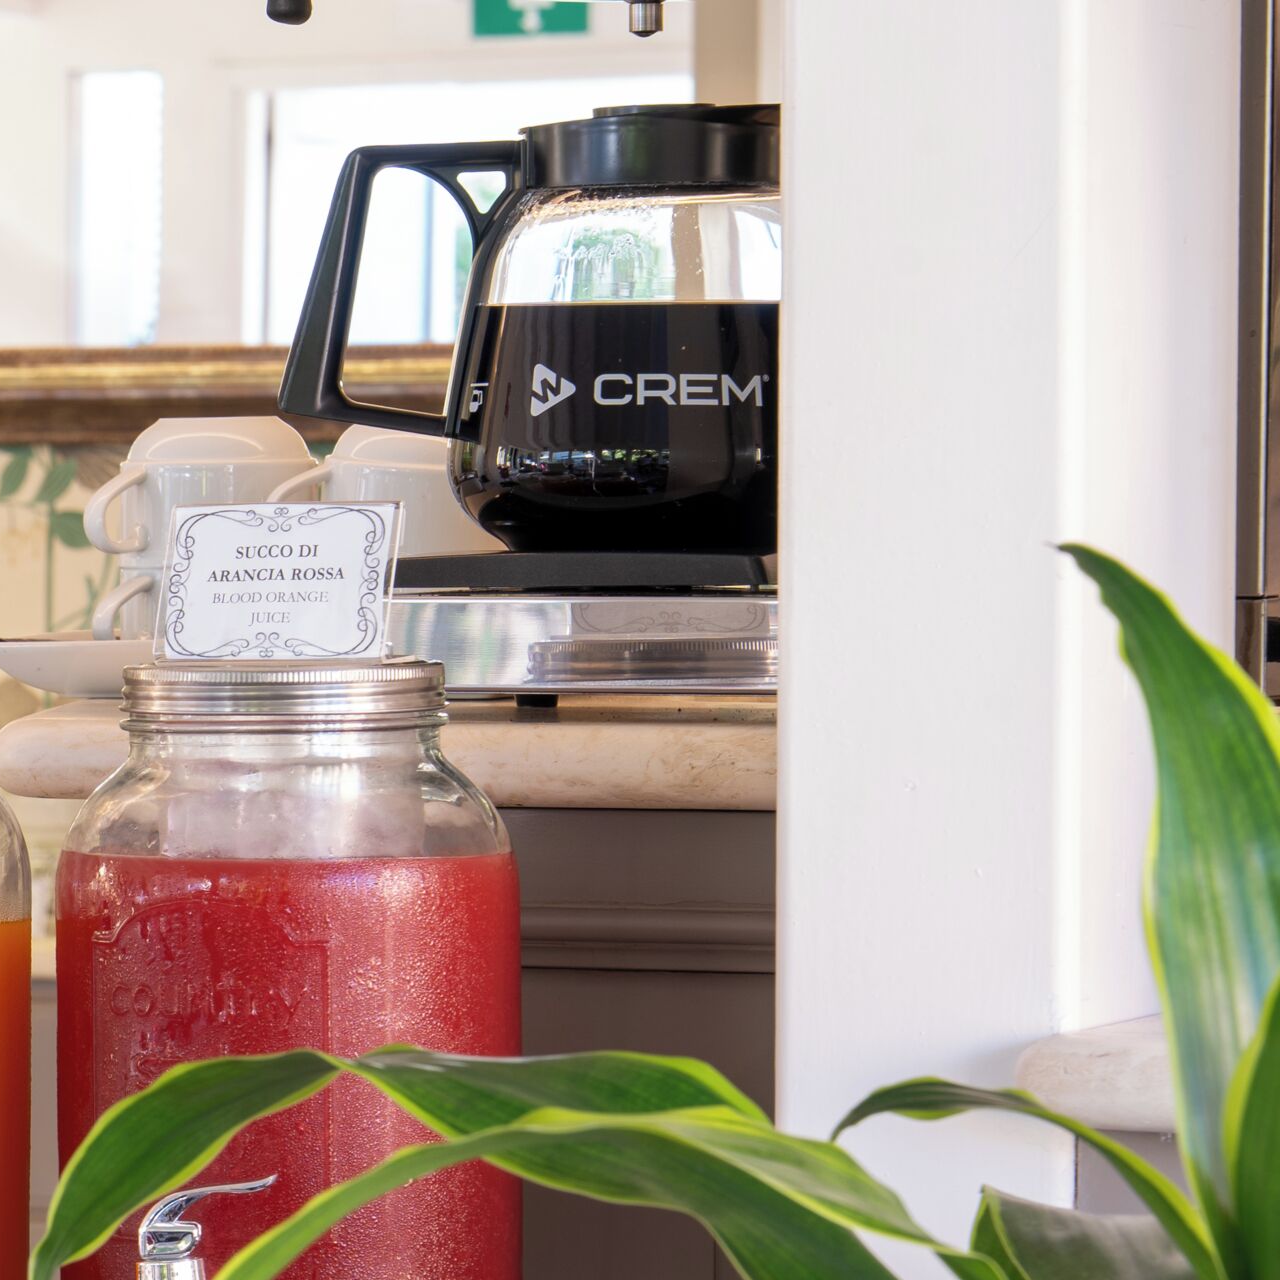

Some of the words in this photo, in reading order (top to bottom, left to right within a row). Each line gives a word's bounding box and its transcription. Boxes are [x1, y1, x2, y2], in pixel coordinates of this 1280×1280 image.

[593, 372, 763, 407] CREM
[235, 544, 293, 560] SUCCO
[298, 544, 319, 558] DI
[207, 569, 285, 583] ARANCIA
[291, 567, 345, 582] ROSSA
[212, 591, 263, 604] BLOOD
[265, 590, 329, 604] ORANGE
[248, 611, 291, 627] JUICE
